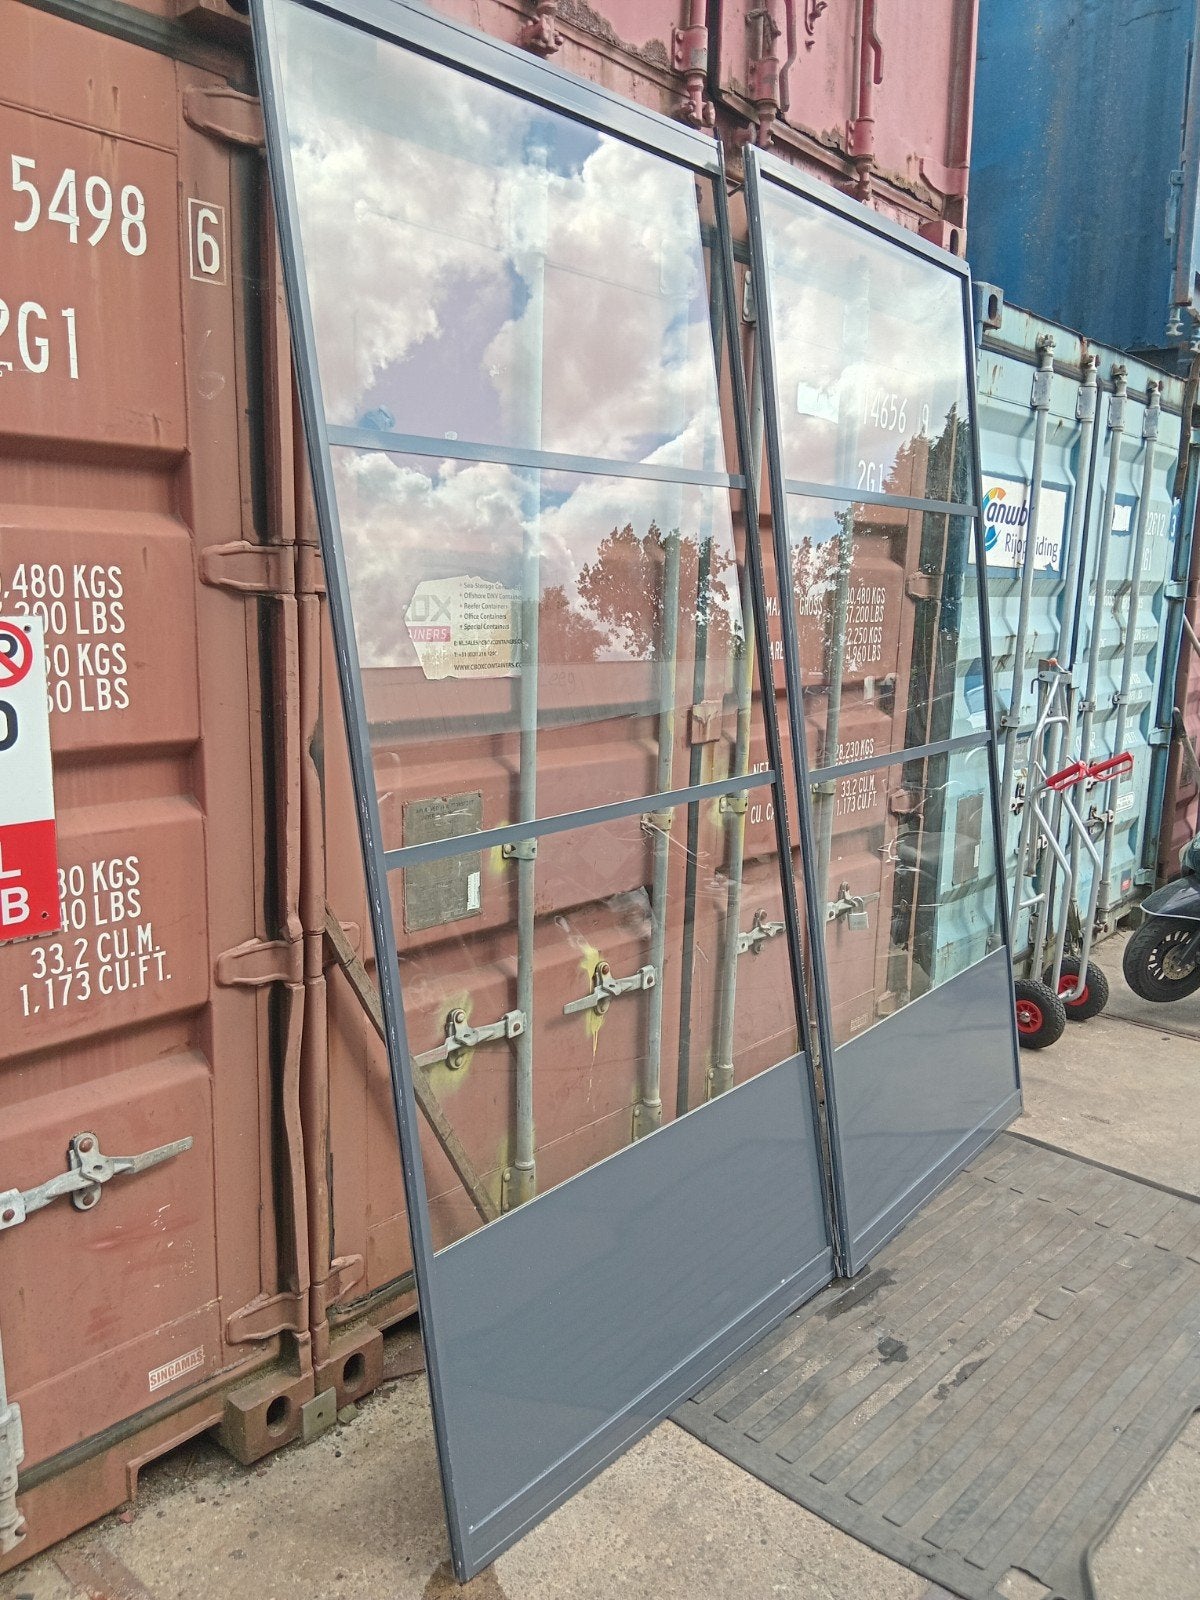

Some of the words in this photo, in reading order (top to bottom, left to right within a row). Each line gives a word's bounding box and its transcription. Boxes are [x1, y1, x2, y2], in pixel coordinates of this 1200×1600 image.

[11, 154, 147, 256] 5498
[197, 208, 220, 275] 6
[987, 500, 1028, 526] anwb
[1005, 533, 1058, 562] Rijopiding
[0, 564, 64, 598] ,480
[74, 565, 123, 598] KGS
[871, 586, 886, 604] KGS
[75, 601, 125, 634] LBS
[405, 594, 451, 621] OX
[481, 612, 507, 620] Containers
[482, 602, 508, 610] Containers
[870, 605, 885, 623] LBS
[869, 626, 882, 643] KGS
[78, 643, 127, 676] KGS
[867, 644, 881, 661] LBS
[79, 677, 130, 711] LBS
[860, 738, 875, 755] KGS
[92, 856, 140, 892] KGS
[94, 888, 141, 926] LBS
[31, 938, 89, 979] 33.2
[97, 923, 160, 962] CU.M.
[20, 970, 91, 1016] 1,173
[98, 951, 172, 995] CU.FT.
[150, 1350, 204, 1386] SINGAMAS
